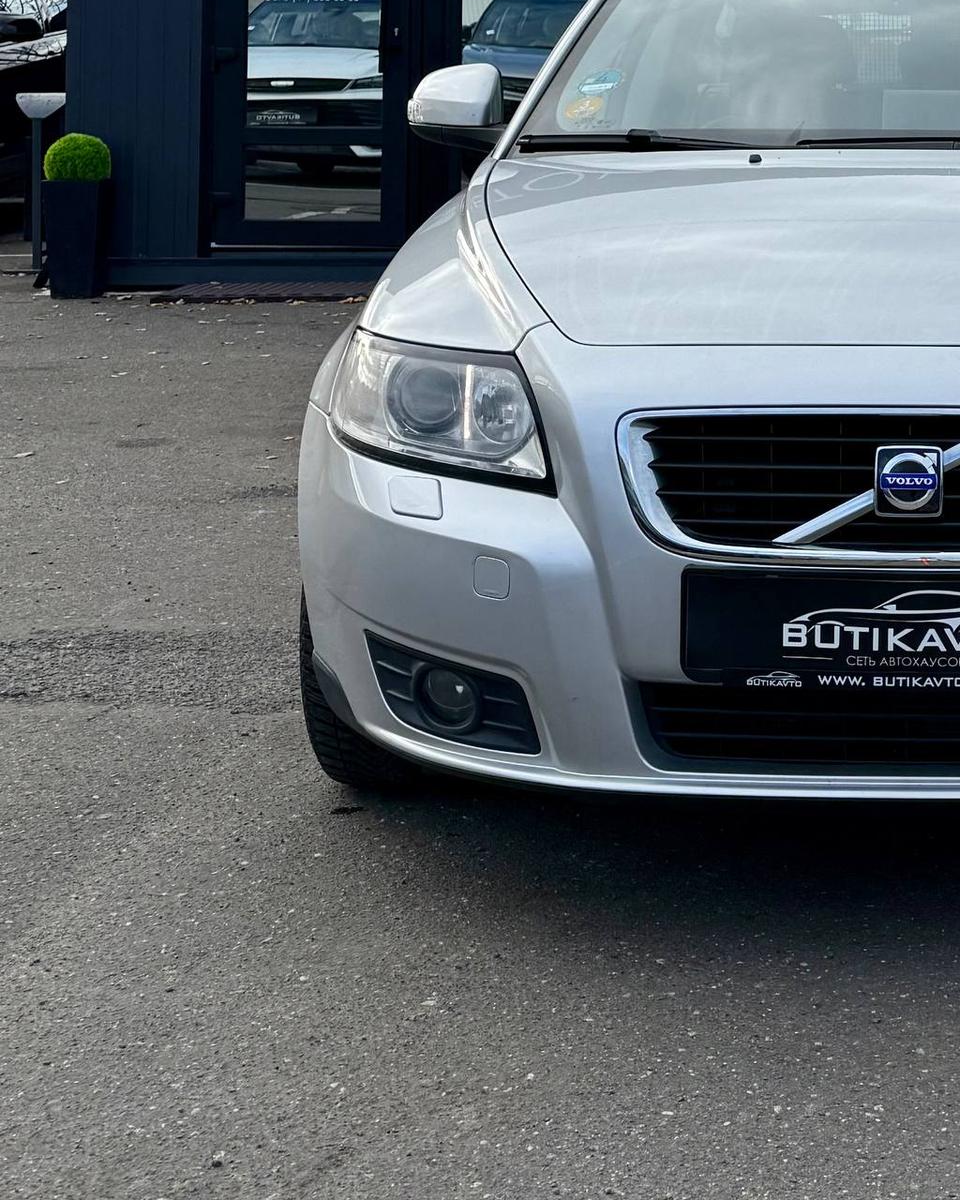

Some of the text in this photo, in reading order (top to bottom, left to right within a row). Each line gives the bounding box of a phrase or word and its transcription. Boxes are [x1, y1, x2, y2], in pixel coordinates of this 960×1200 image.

[885, 477, 933, 486] VOLVO
[846, 655, 876, 667] СЕТЬ
[746, 678, 803, 688] BUTIKAVTO
